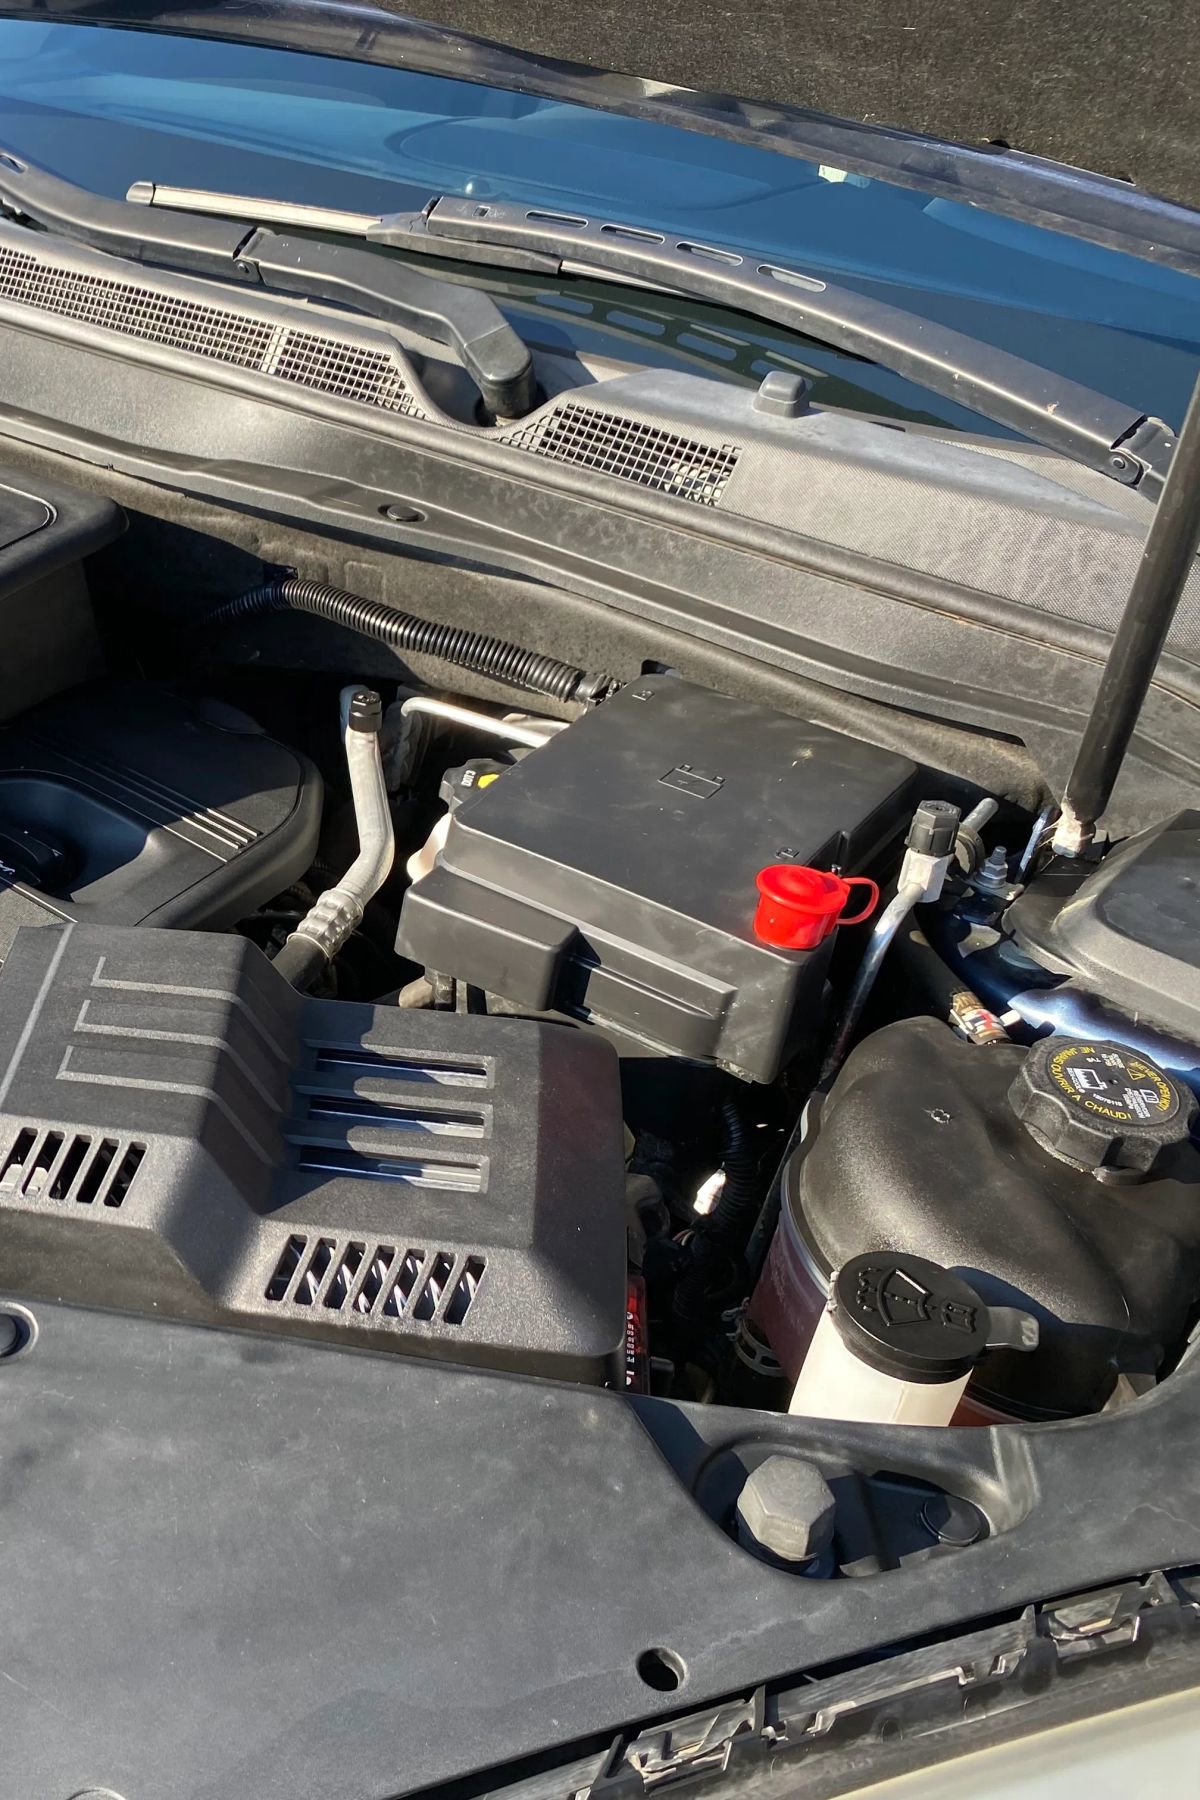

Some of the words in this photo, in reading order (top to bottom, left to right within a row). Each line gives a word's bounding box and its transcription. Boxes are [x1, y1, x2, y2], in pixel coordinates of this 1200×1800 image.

[1128, 1062, 1161, 1081] NEVER
[1051, 1064, 1075, 1093] OUVRIR
[1084, 1100, 1132, 1119] CHAUD!
